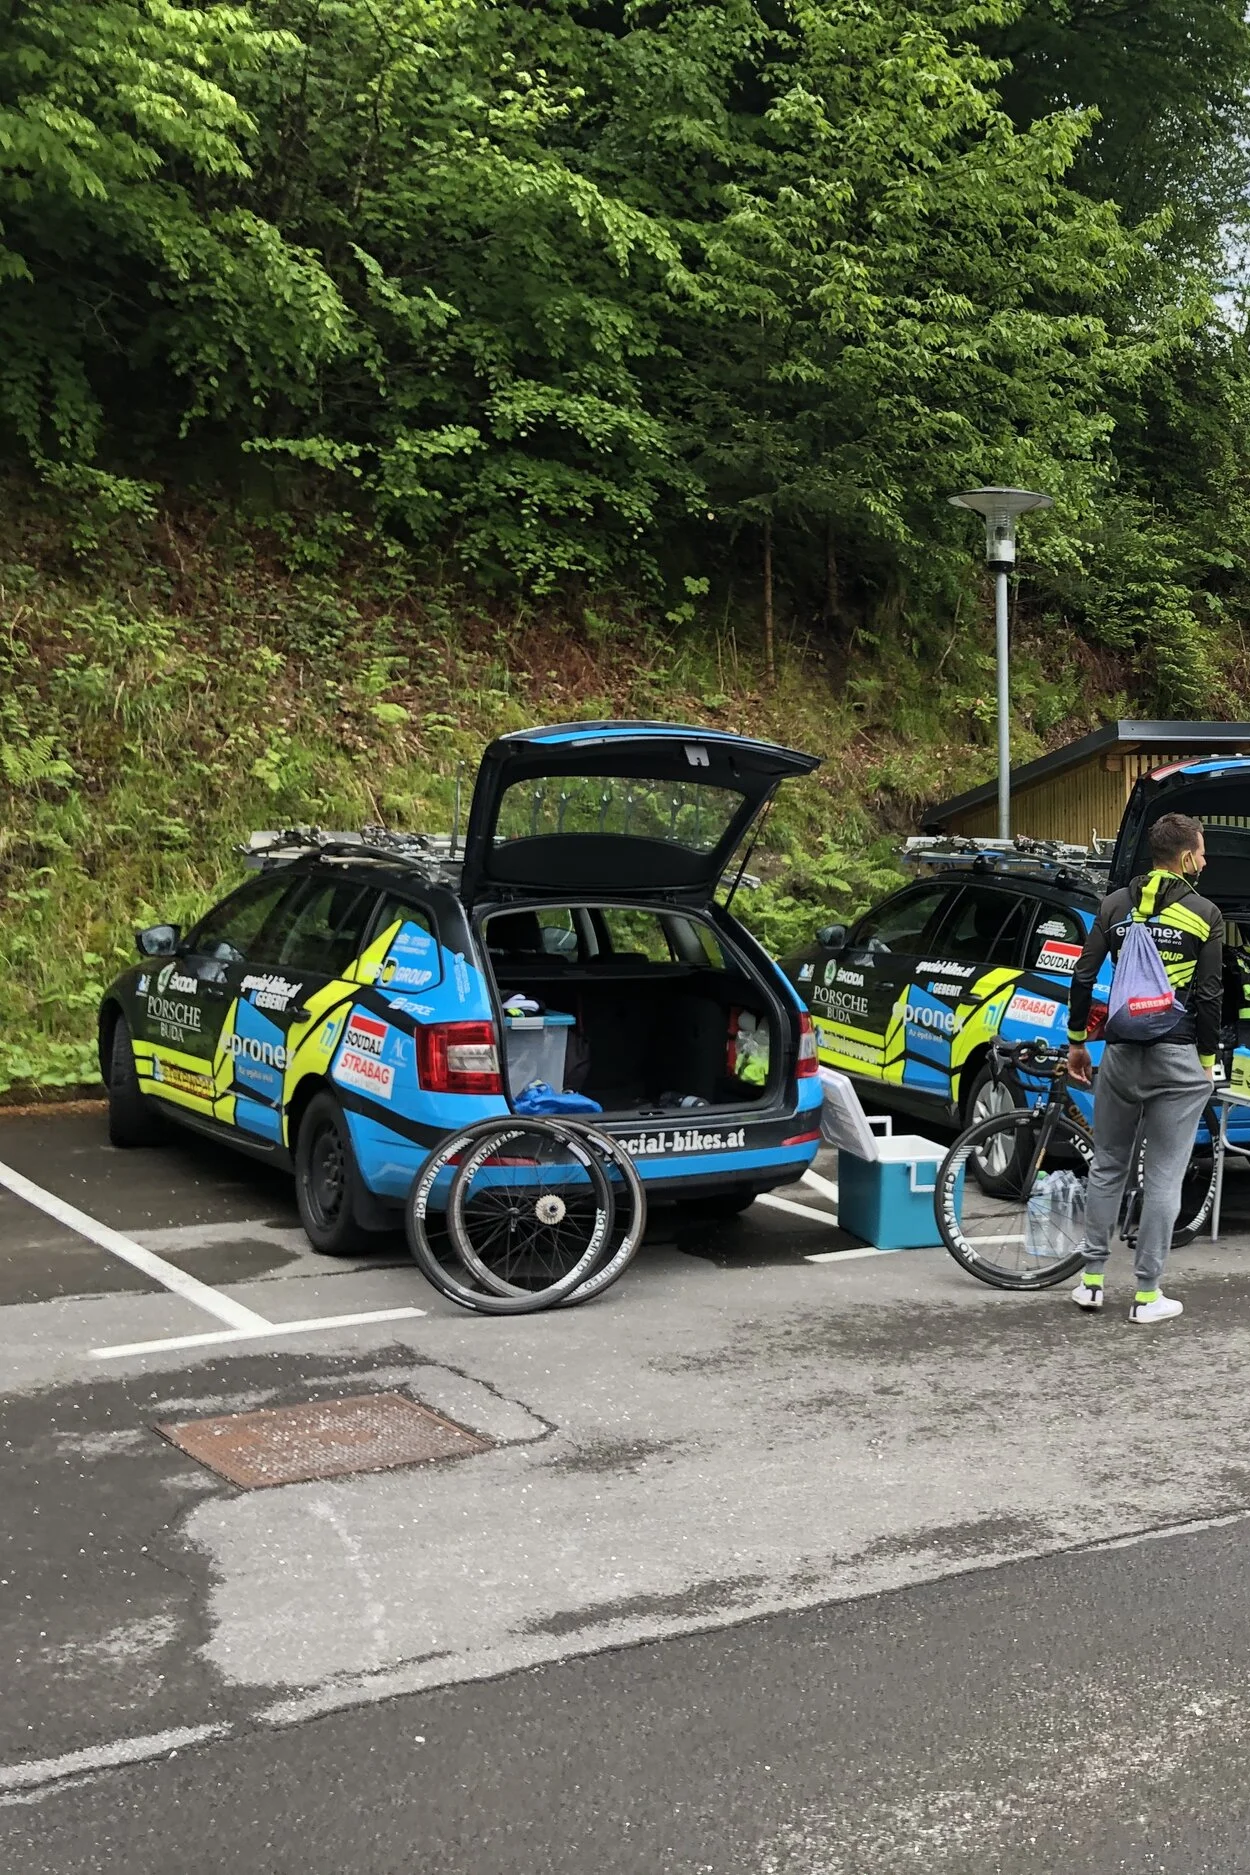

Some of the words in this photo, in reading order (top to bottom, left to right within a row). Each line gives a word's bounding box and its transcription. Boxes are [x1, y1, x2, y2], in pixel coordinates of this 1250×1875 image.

[1037, 953, 1076, 971] SOUDAL
[169, 972, 198, 994] ŠKODA
[836, 967, 864, 987] ŠKODA
[814, 985, 869, 1014] PORSCHE
[1011, 996, 1057, 1017] STRABAG
[147, 995, 201, 1028] PORSCHE
[827, 1007, 851, 1024] BUDA
[160, 1021, 185, 1043] BUDA
[345, 1030, 382, 1057] SOUDAL
[341, 1053, 390, 1084] STRABAG
[618, 1128, 746, 1155] ecial-bikes.at
